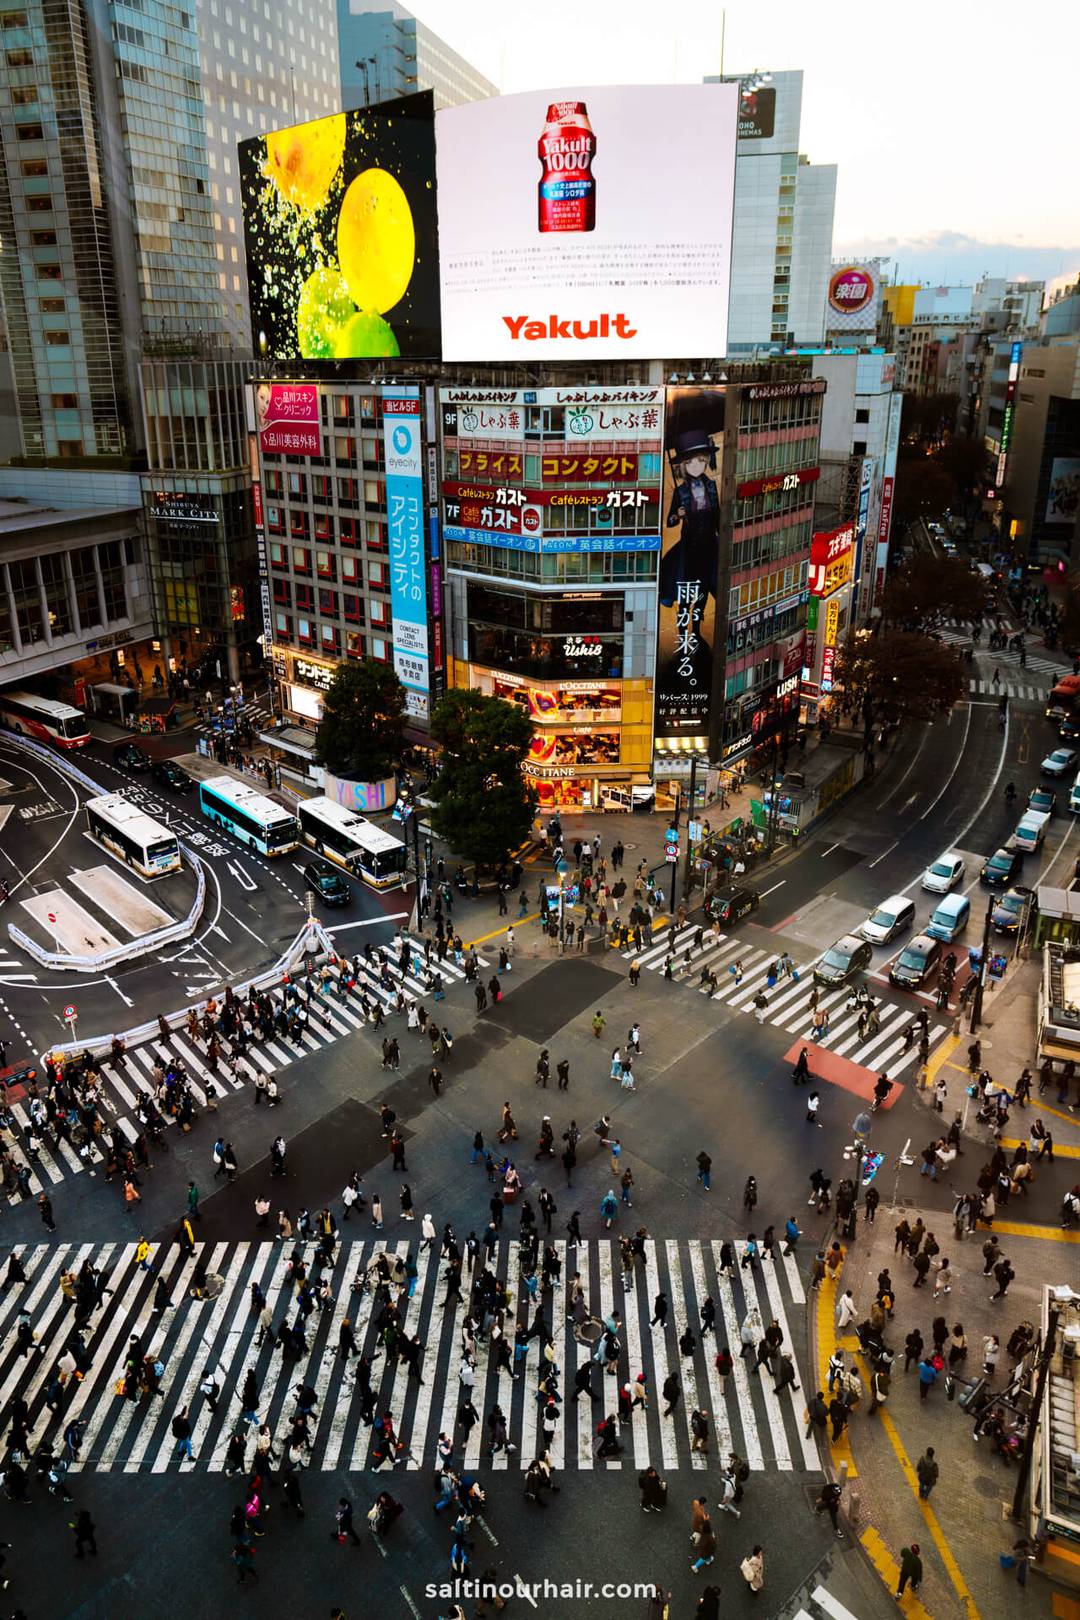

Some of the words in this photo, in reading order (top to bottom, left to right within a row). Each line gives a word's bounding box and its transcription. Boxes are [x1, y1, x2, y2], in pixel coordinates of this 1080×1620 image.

[738, 121, 755, 129] OHO
[543, 135, 592, 154] Yakult
[543, 152, 590, 172] 1000
[502, 313, 637, 340] Yakult
[282, 391, 315, 403] 品川スキン
[448, 391, 517, 403] しゃぶしゃぶバイキング
[556, 390, 659, 403] しゃぶしゃぶバイキング
[283, 404, 312, 416] クリニック
[386, 401, 416, 413] 当ビル5F
[445, 413, 457, 425] 9F
[479, 411, 520, 430] しゃぶ葉
[598, 409, 659, 430] しゃぶ葉
[268, 433, 317, 449] 品川美容外科
[389, 458, 417, 469] eyecity
[543, 457, 635, 476] コンタクト
[495, 488, 527, 507] ガスト
[606, 490, 649, 508] ガスト
[150, 506, 185, 517] MARK
[190, 508, 220, 519] CITY
[446, 504, 460, 518] 7F
[480, 507, 519, 529] ガスト
[390, 494, 409, 599] アイシティ
[468, 530, 523, 547] 英会話イーオン
[579, 539, 659, 550] 英会話イーオン
[407, 498, 423, 602] コンタクトの
[674, 580, 702, 686] 雨が来る。
[563, 643, 603, 657] Ushi8
[776, 675, 798, 699] LUSH
